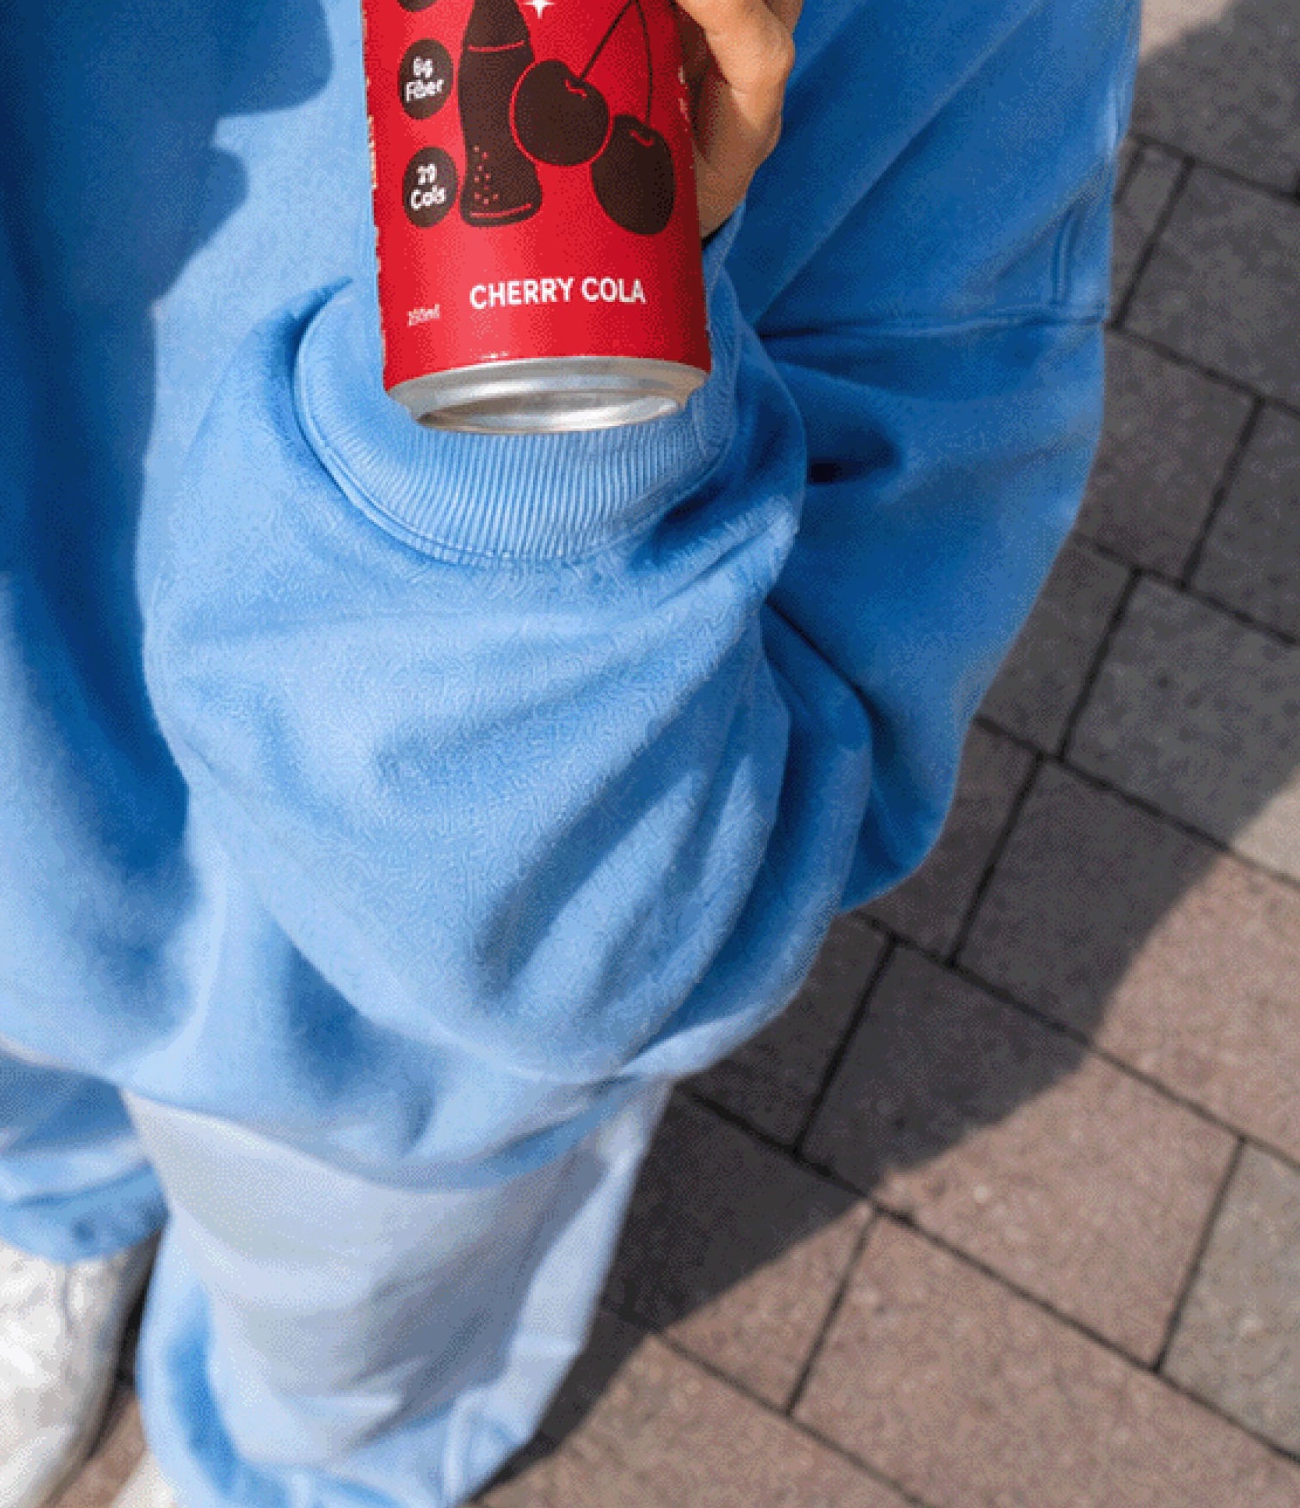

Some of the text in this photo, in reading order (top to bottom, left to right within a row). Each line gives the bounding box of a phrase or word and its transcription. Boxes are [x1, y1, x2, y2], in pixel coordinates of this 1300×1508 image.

[405, 80, 444, 103] Fiber
[469, 277, 646, 309] CHERRY COLA
